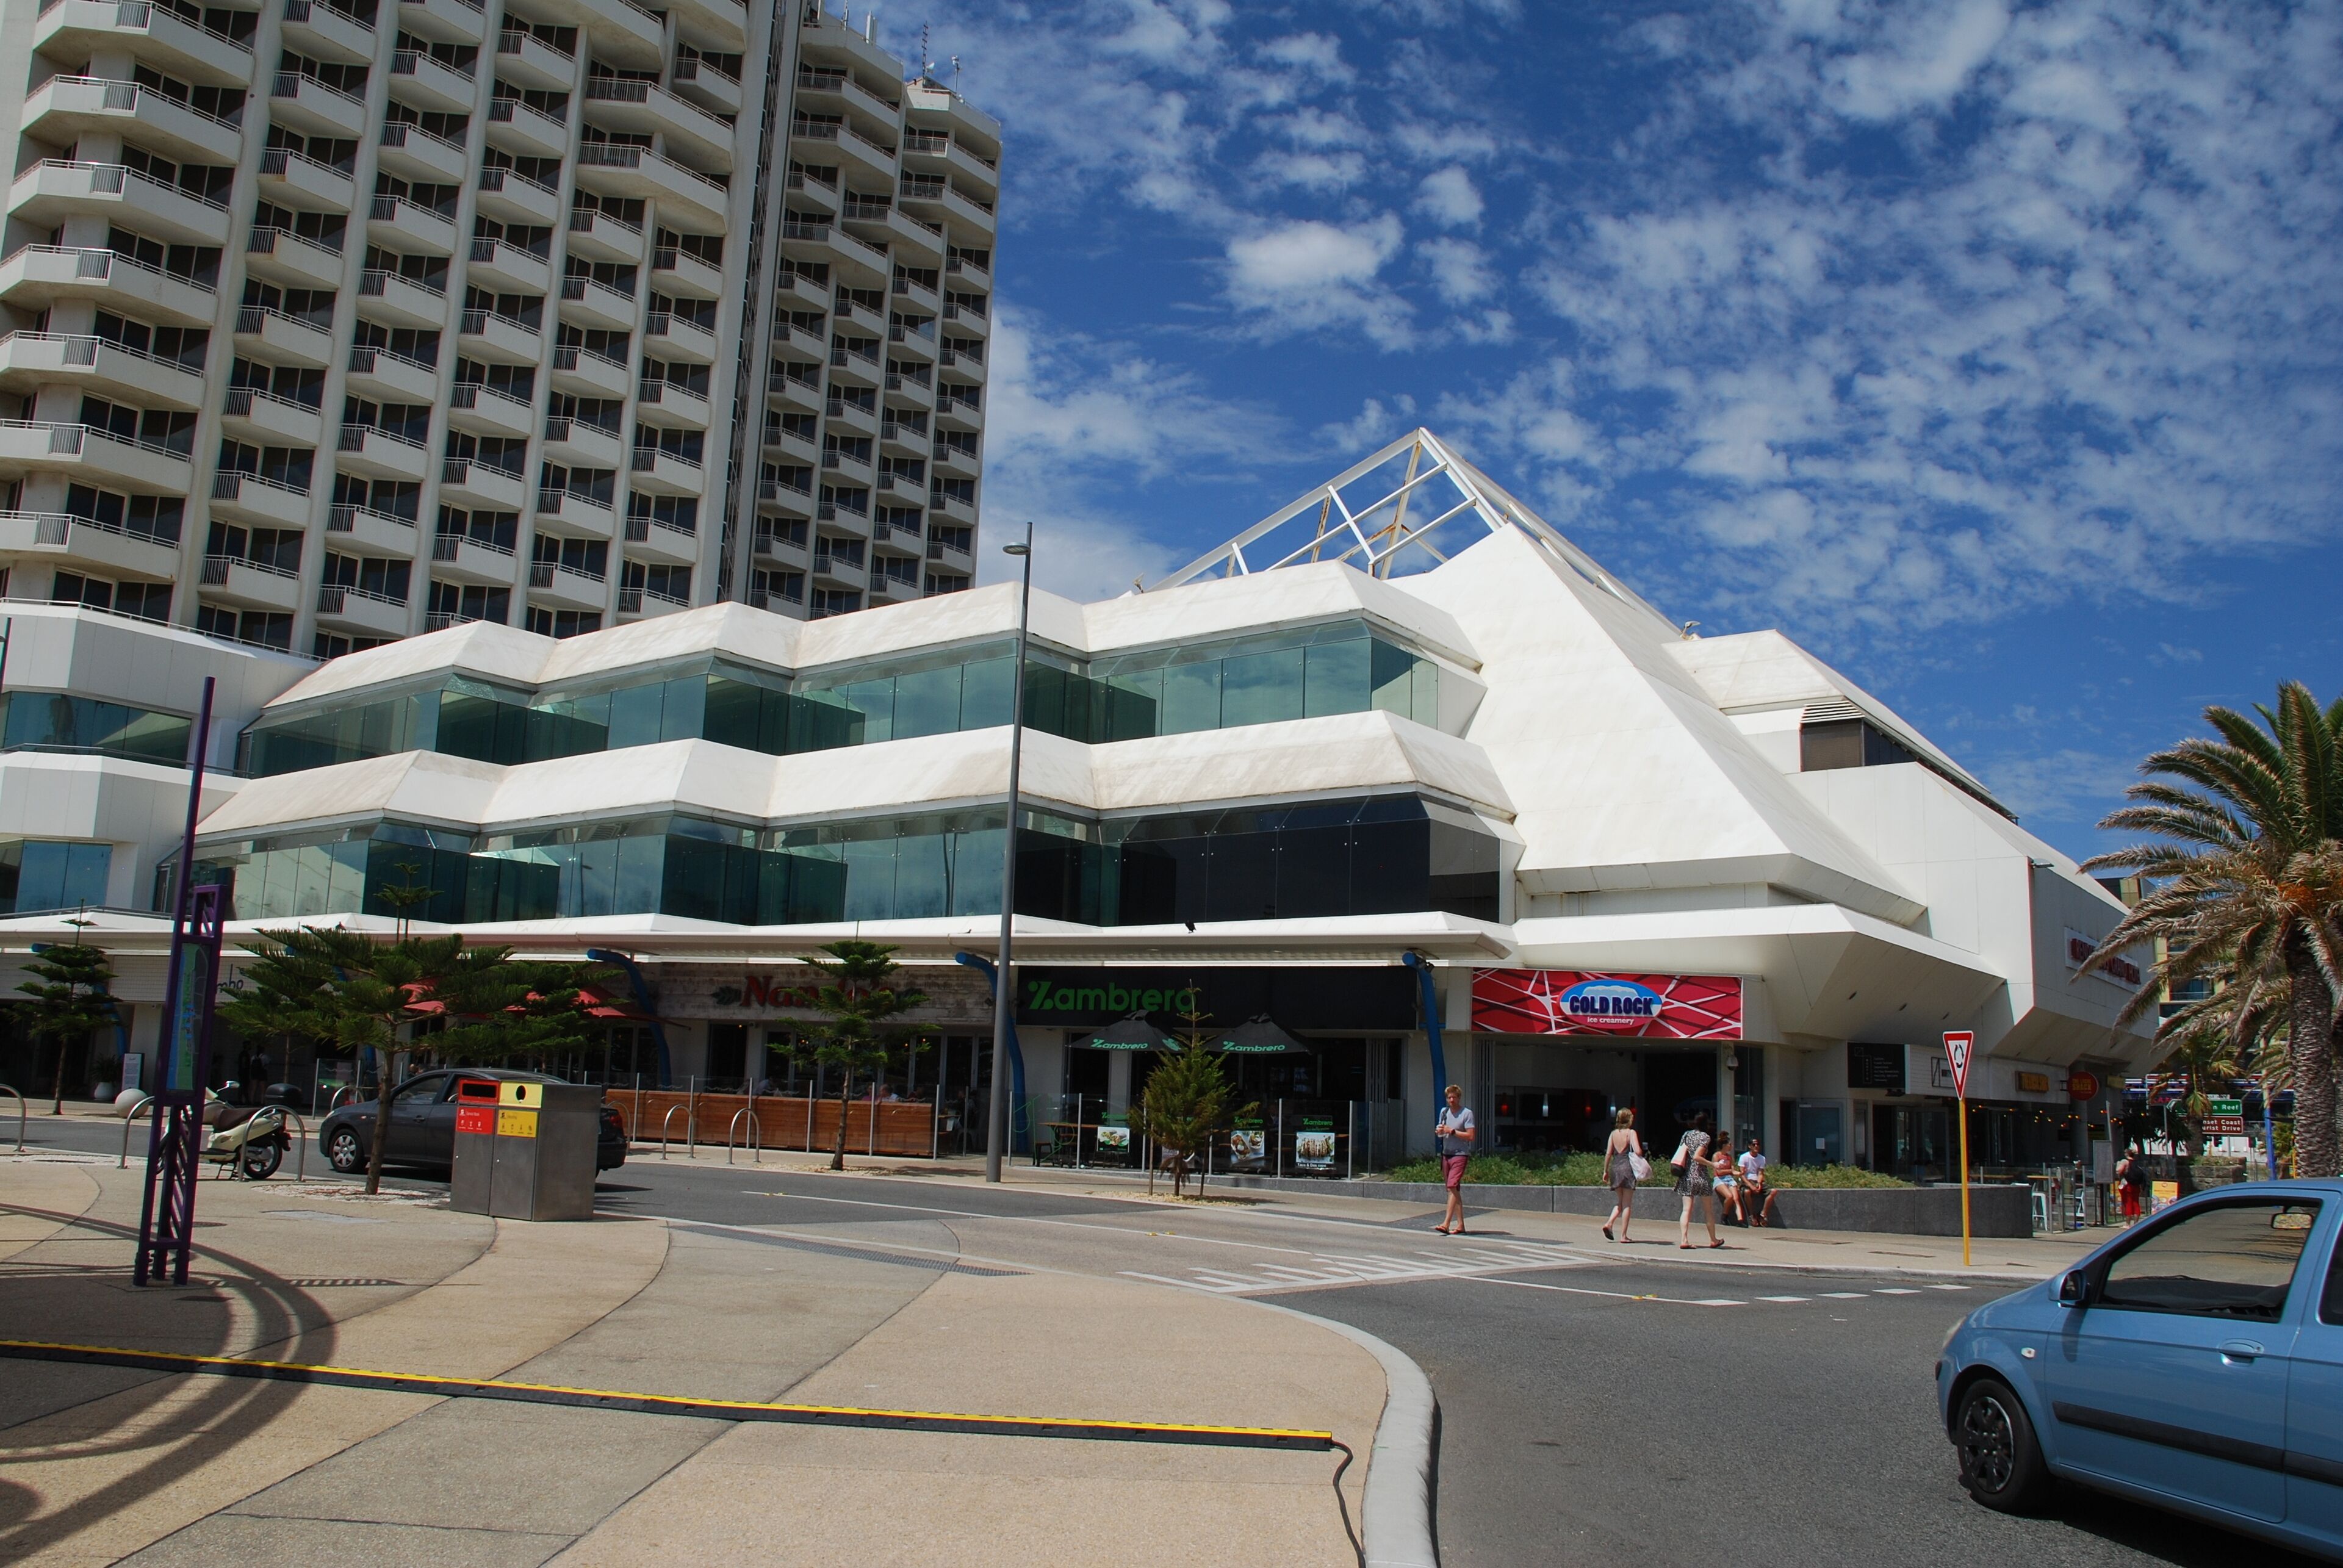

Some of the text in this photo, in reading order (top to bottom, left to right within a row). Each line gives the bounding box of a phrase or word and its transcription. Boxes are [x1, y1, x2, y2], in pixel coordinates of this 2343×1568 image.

[1028, 980, 1197, 1012] Zambrero
[1569, 995, 1654, 1016] COLD ROCK
[1090, 1038, 1148, 1049] Zambrero
[1222, 1041, 1286, 1052] Zambrero
